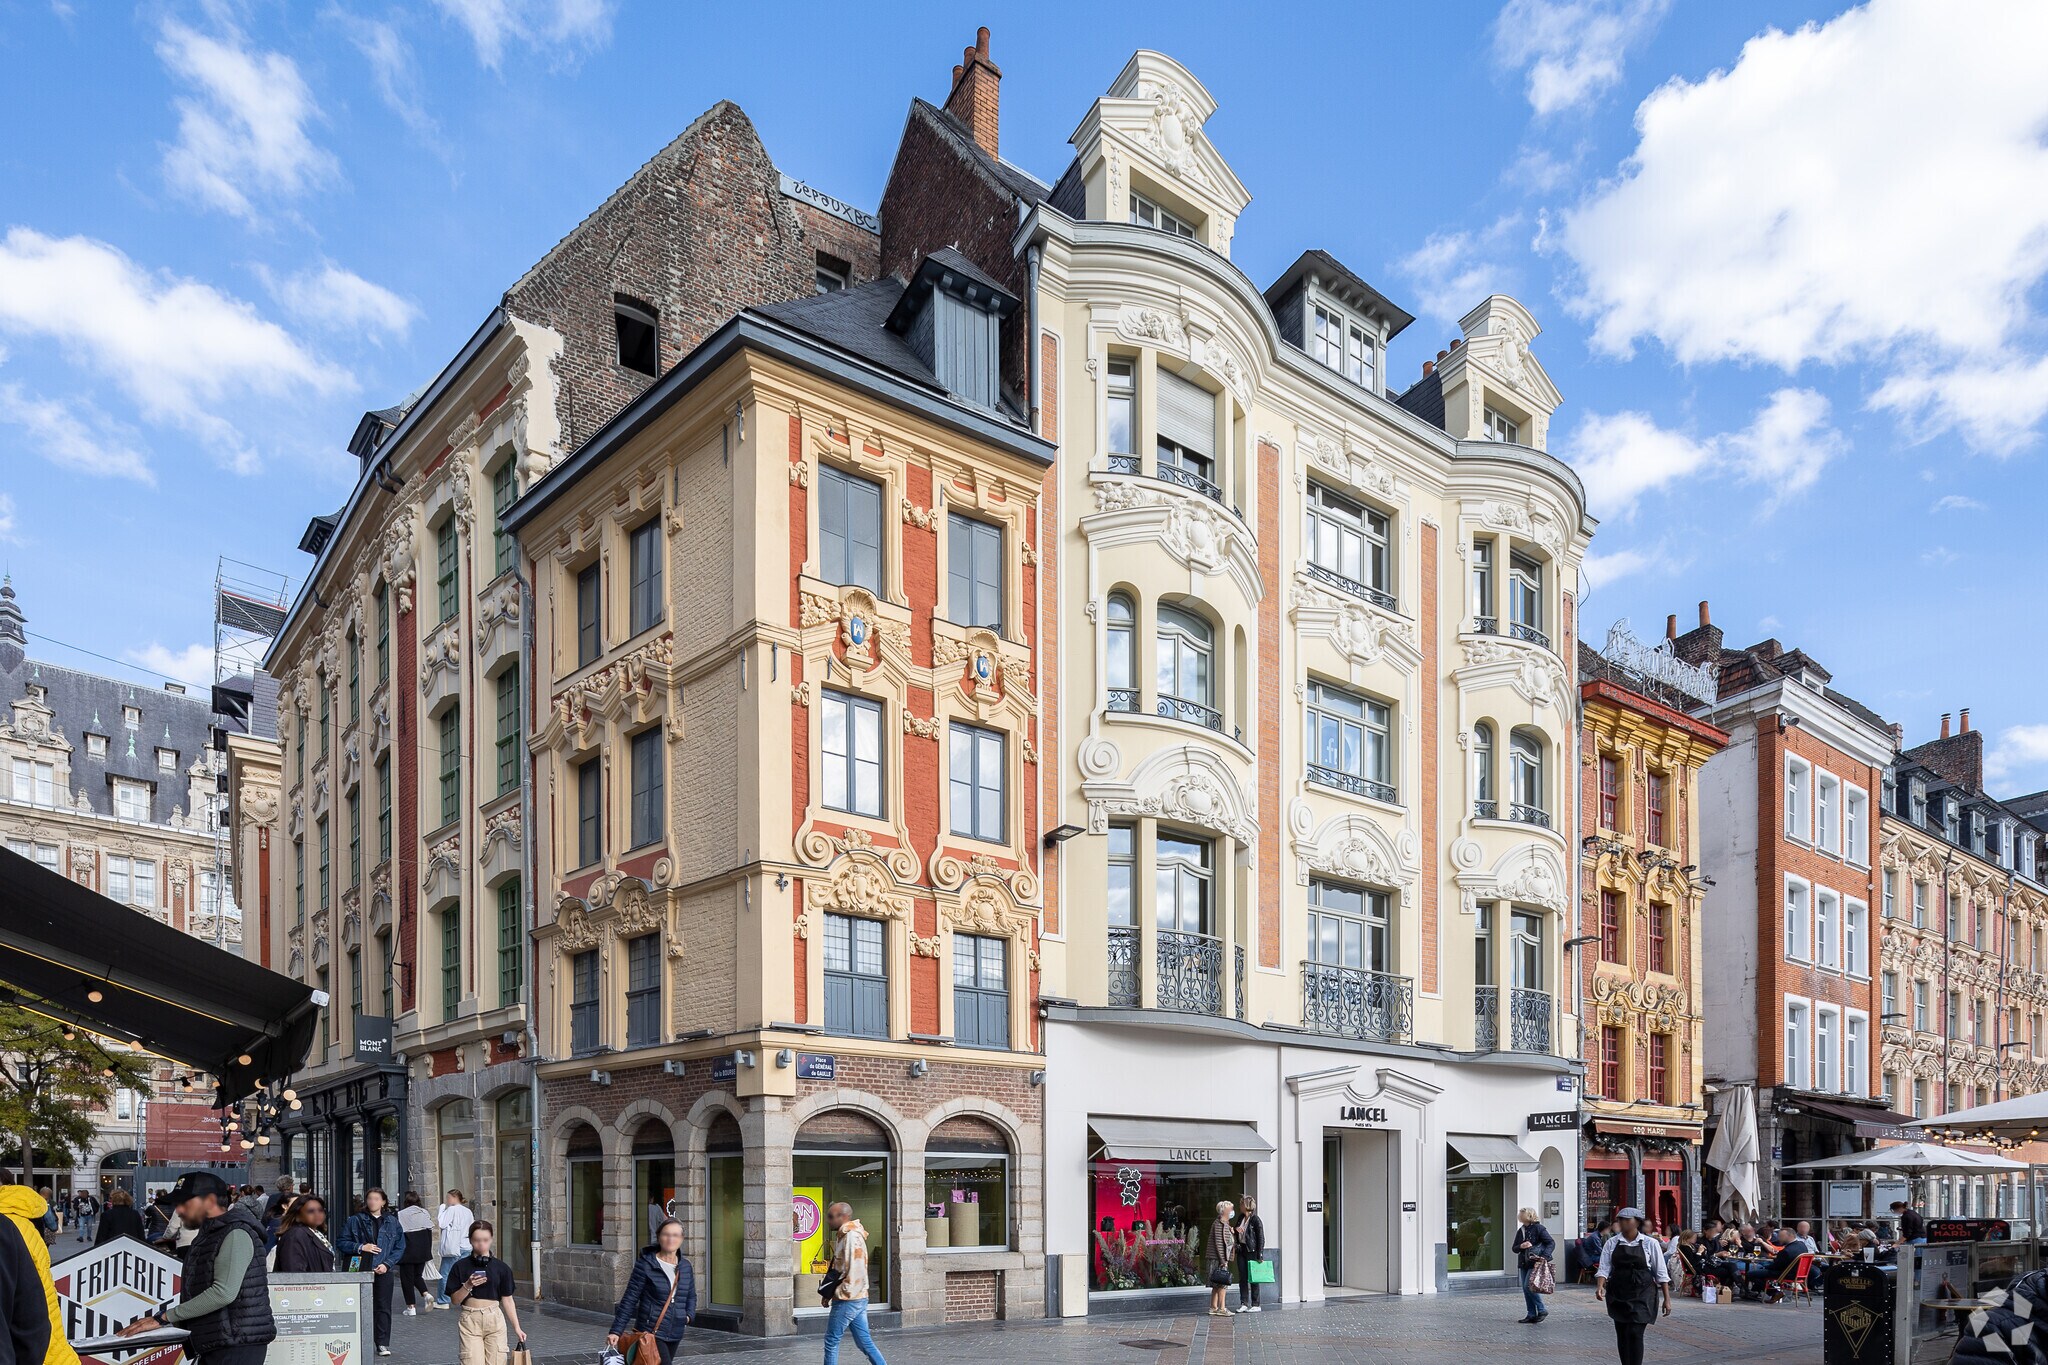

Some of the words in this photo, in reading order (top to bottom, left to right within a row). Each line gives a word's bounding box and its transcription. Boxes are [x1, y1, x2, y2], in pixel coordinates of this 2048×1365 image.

[1340, 1106, 1388, 1122] LANCEL
[1534, 1115, 1572, 1124] LANCEL
[1633, 1126, 1645, 1135] COQ
[1647, 1127, 1666, 1136] HARDI
[1170, 1149, 1212, 1160] LANCEL
[1490, 1163, 1519, 1172] LANCEL
[1545, 1178, 1560, 1189] 46
[1591, 1181, 1606, 1191] COQ
[1588, 1190, 1608, 1198] HARDI
[77, 1250, 166, 1303] FRITERIE
[150, 1351, 162, 1361] EN
